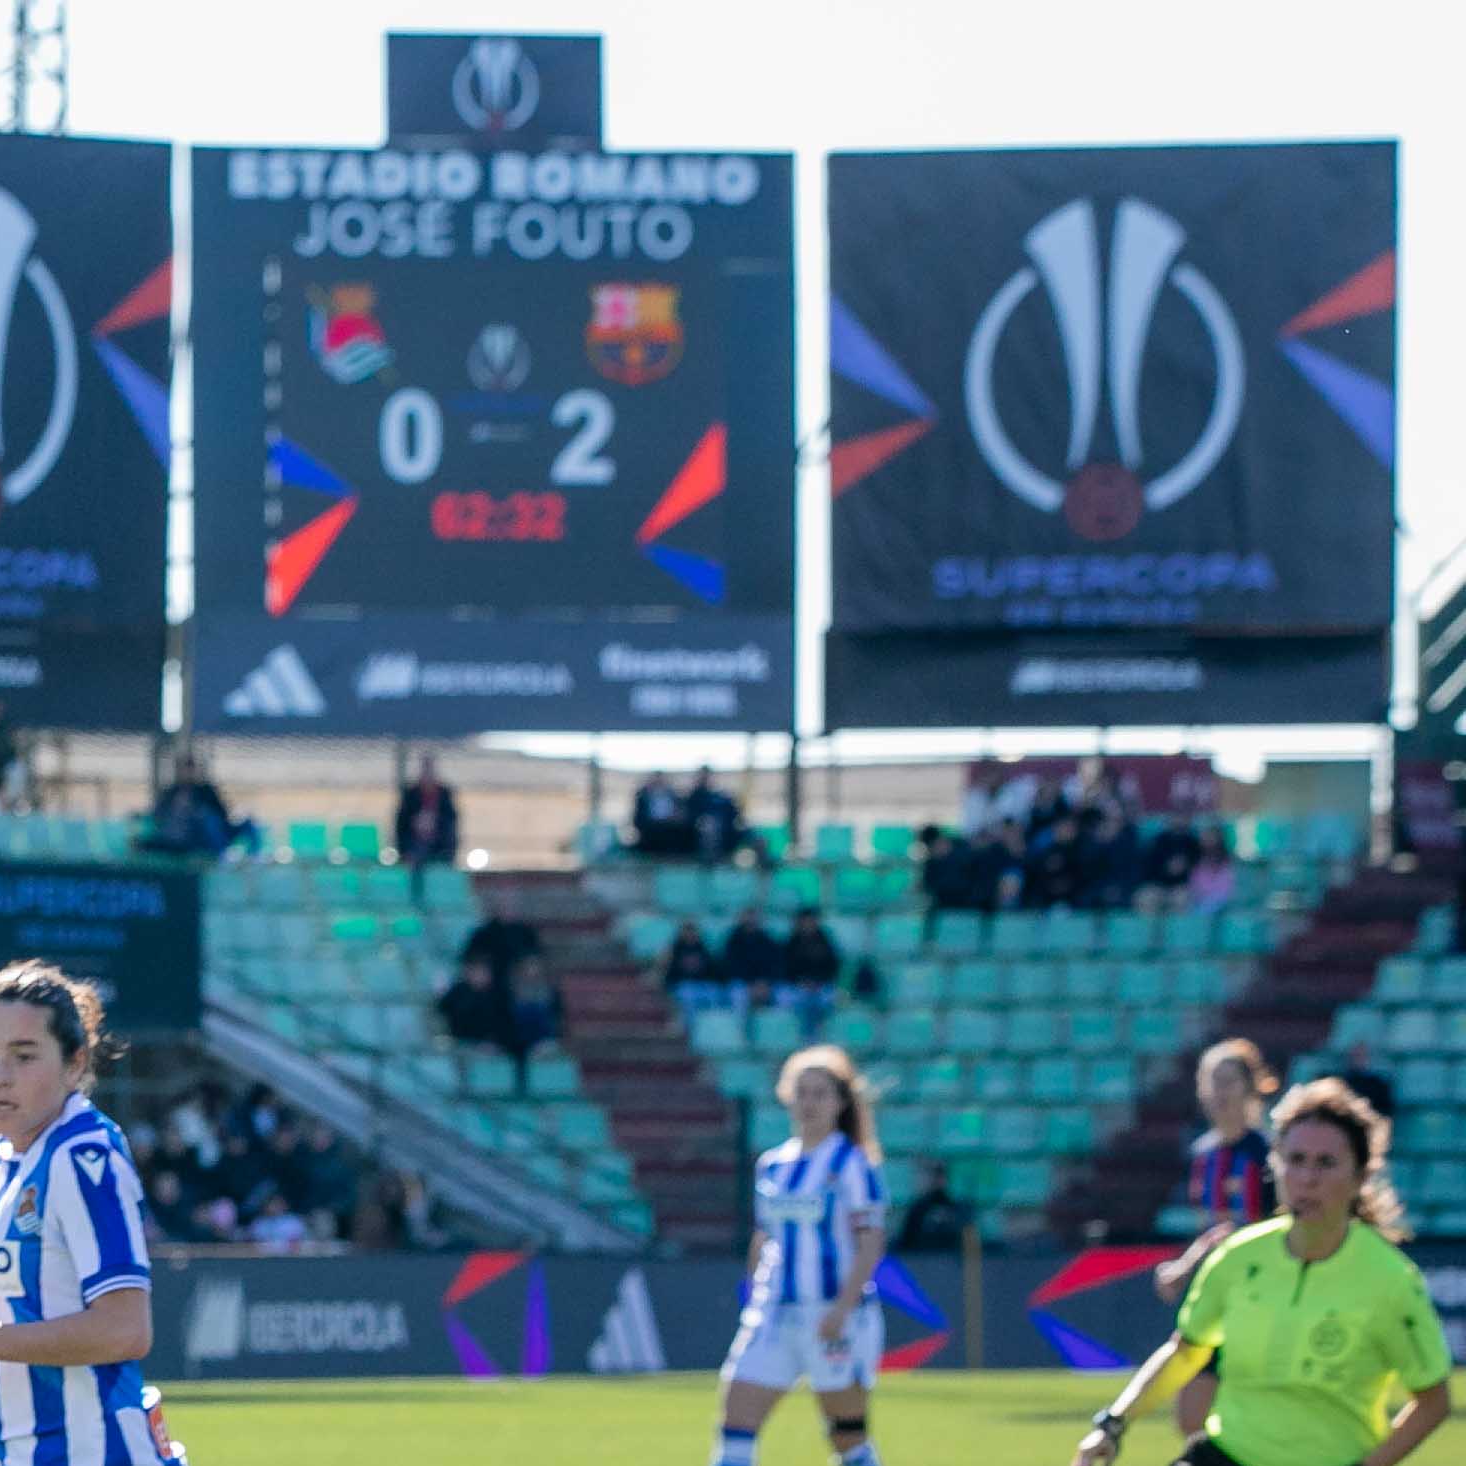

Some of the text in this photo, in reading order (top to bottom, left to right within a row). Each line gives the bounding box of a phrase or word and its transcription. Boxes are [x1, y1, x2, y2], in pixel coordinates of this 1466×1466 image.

[228, 150, 760, 206] ESTADIO ROMANO
[472, 203, 694, 261] FOUTO
[379, 387, 617, 486] 0 2
[932, 553, 1277, 599] SUPERCOPA
[250, 1300, 410, 1352] IBERDROLA
